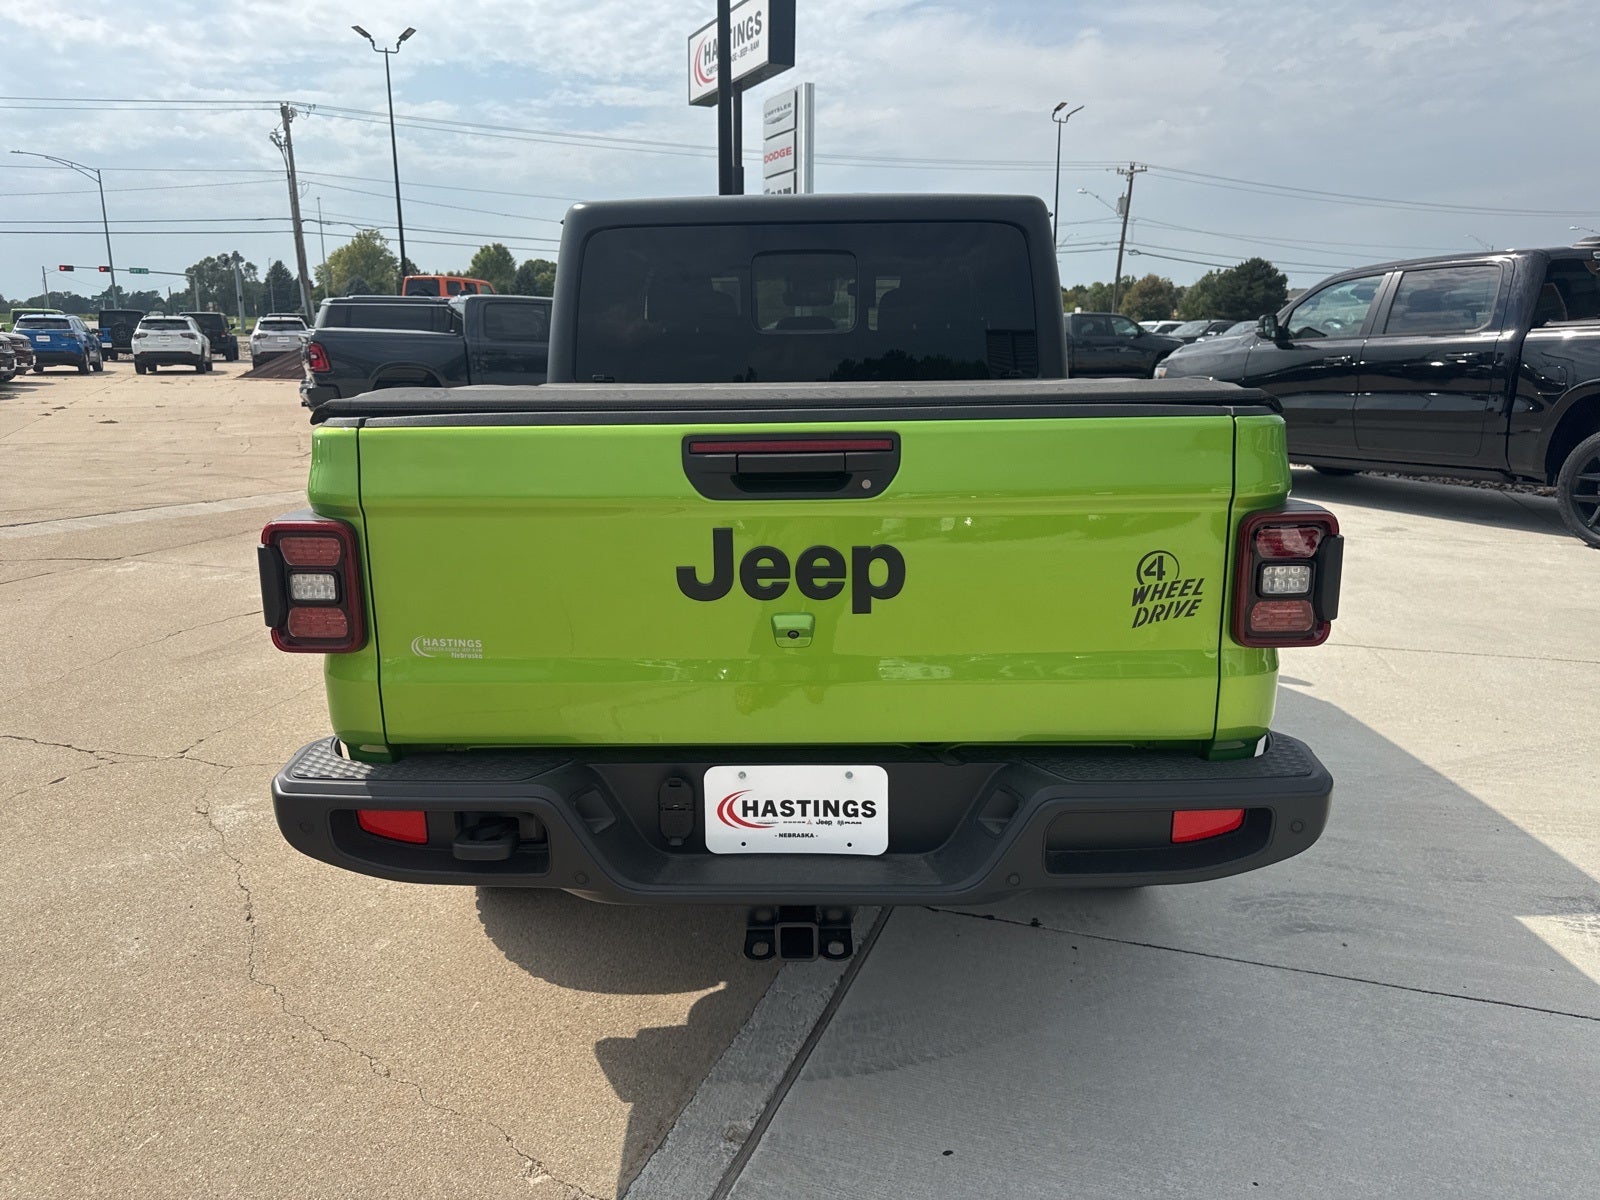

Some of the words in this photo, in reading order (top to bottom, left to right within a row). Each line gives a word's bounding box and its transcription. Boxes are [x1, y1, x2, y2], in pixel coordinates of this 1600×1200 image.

[704, 10, 762, 66] HAINGS
[764, 102, 792, 118] CHRYSLER
[764, 146, 792, 164] DODGE
[676, 527, 906, 614] Jeep
[1143, 555, 1166, 581] 4
[1131, 578, 1205, 607] WHEEL
[1131, 599, 1203, 629] DRIVE
[422, 638, 482, 648] HASTINGS
[741, 799, 877, 818] HASTINGS
